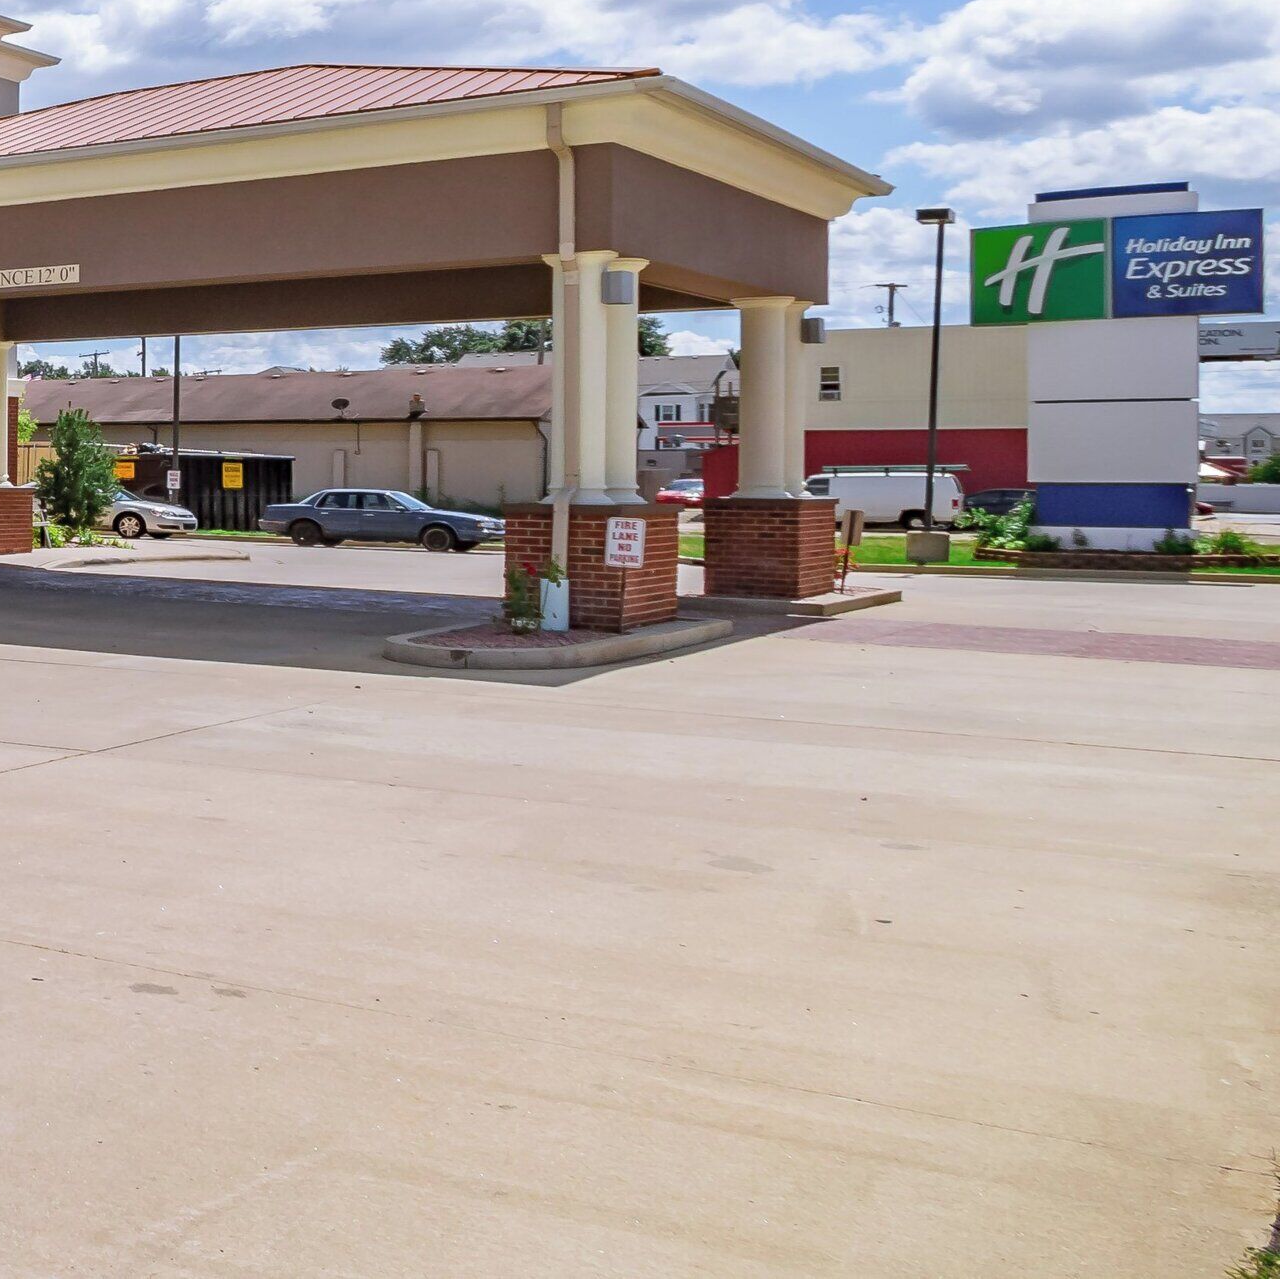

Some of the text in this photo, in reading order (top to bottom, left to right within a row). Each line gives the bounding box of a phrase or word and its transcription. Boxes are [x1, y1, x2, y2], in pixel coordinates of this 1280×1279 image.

[1125, 233, 1252, 254] Holiday Inn
[1125, 256, 1252, 283] Express
[1146, 282, 1228, 299] & Suites
[615, 521, 637, 530] FIRE
[612, 532, 638, 541] LANE
[618, 543, 632, 551] NO
